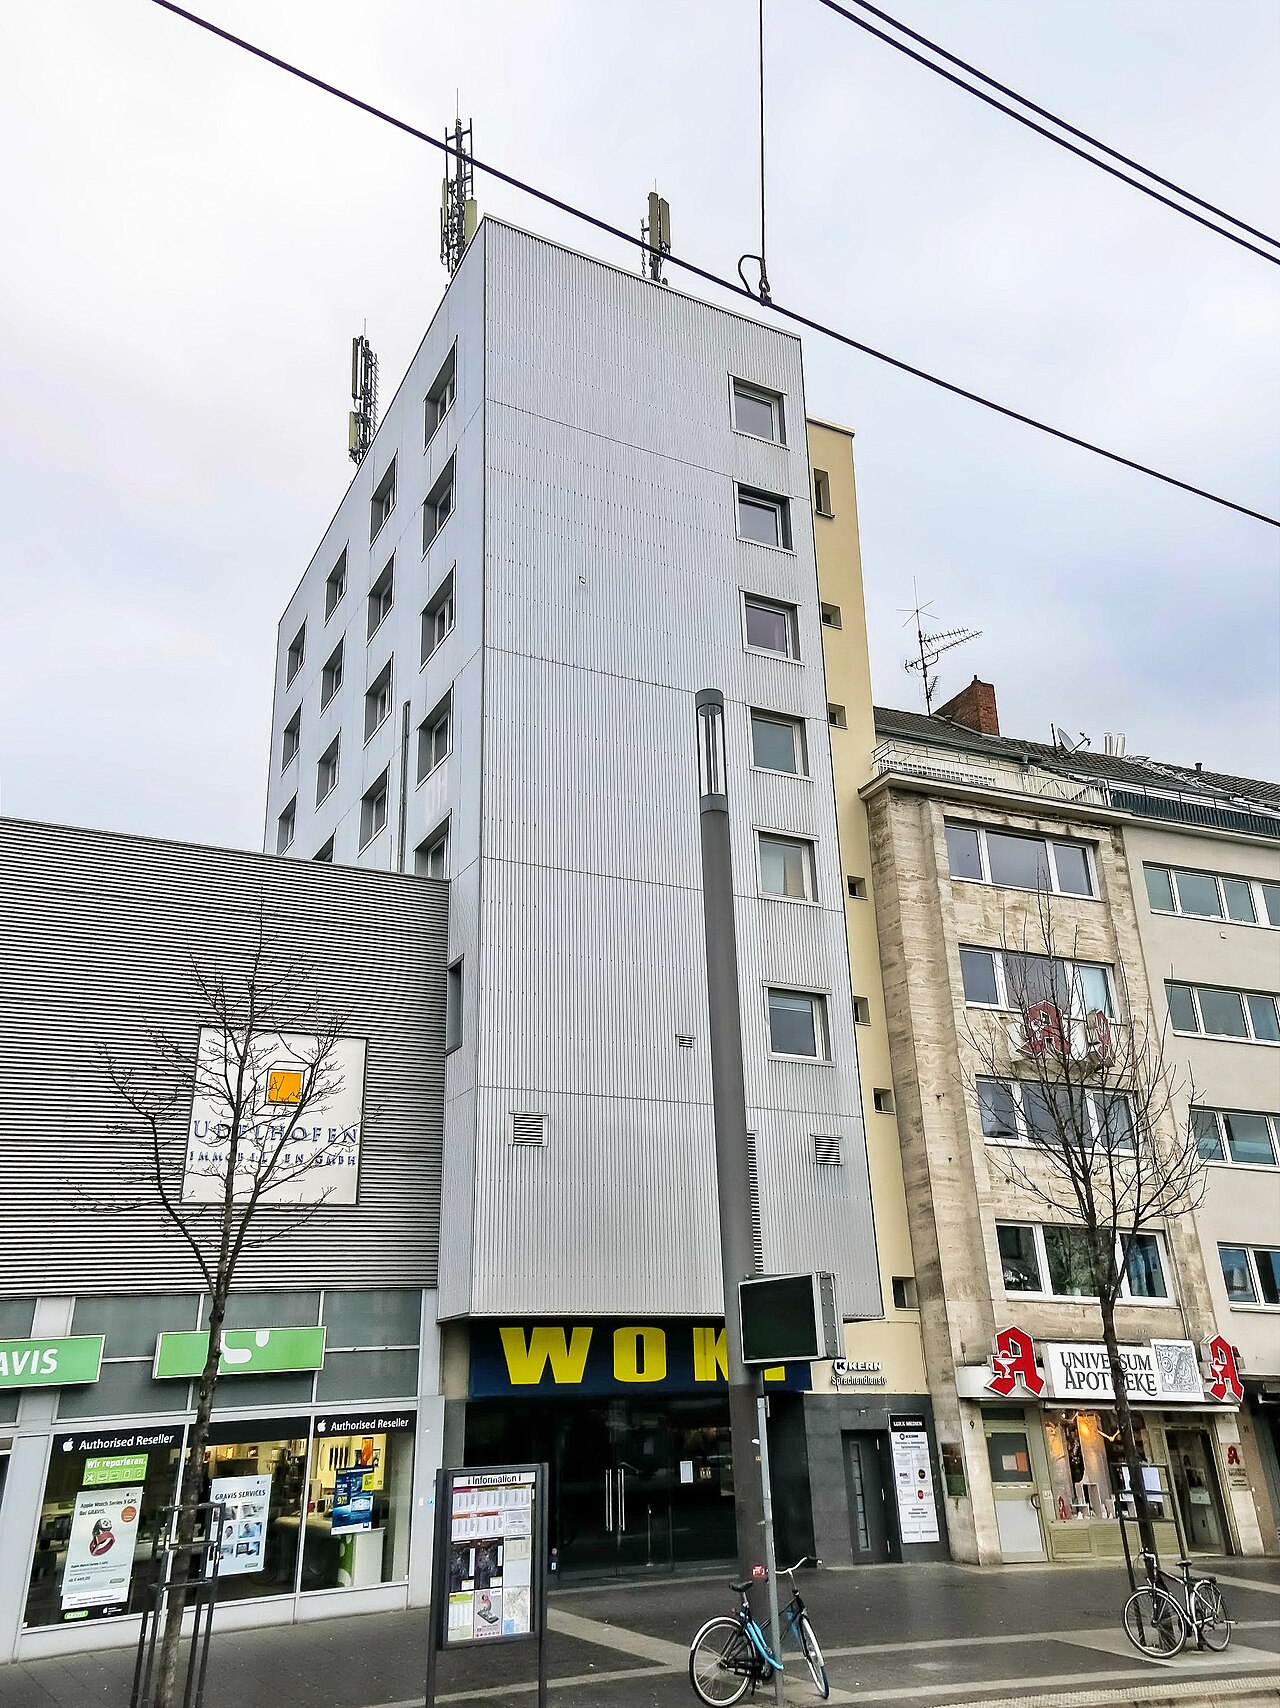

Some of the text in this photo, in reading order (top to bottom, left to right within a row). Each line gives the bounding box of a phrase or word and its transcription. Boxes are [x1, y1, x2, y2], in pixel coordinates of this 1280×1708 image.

[499, 1327, 785, 1385] WOK
[1060, 1351, 1153, 1372] UNIVESUM
[848, 1361, 882, 1371] KERN
[1064, 1362, 1158, 1397] APOTEKE
[330, 1418, 409, 1431] Authorised Reseller
[78, 1434, 174, 1450] Authorised Reseller
[87, 1459, 100, 1469] Wir
[472, 1474, 517, 1485] Information
[215, 1489, 266, 1500] GRAVIS SERVICES
